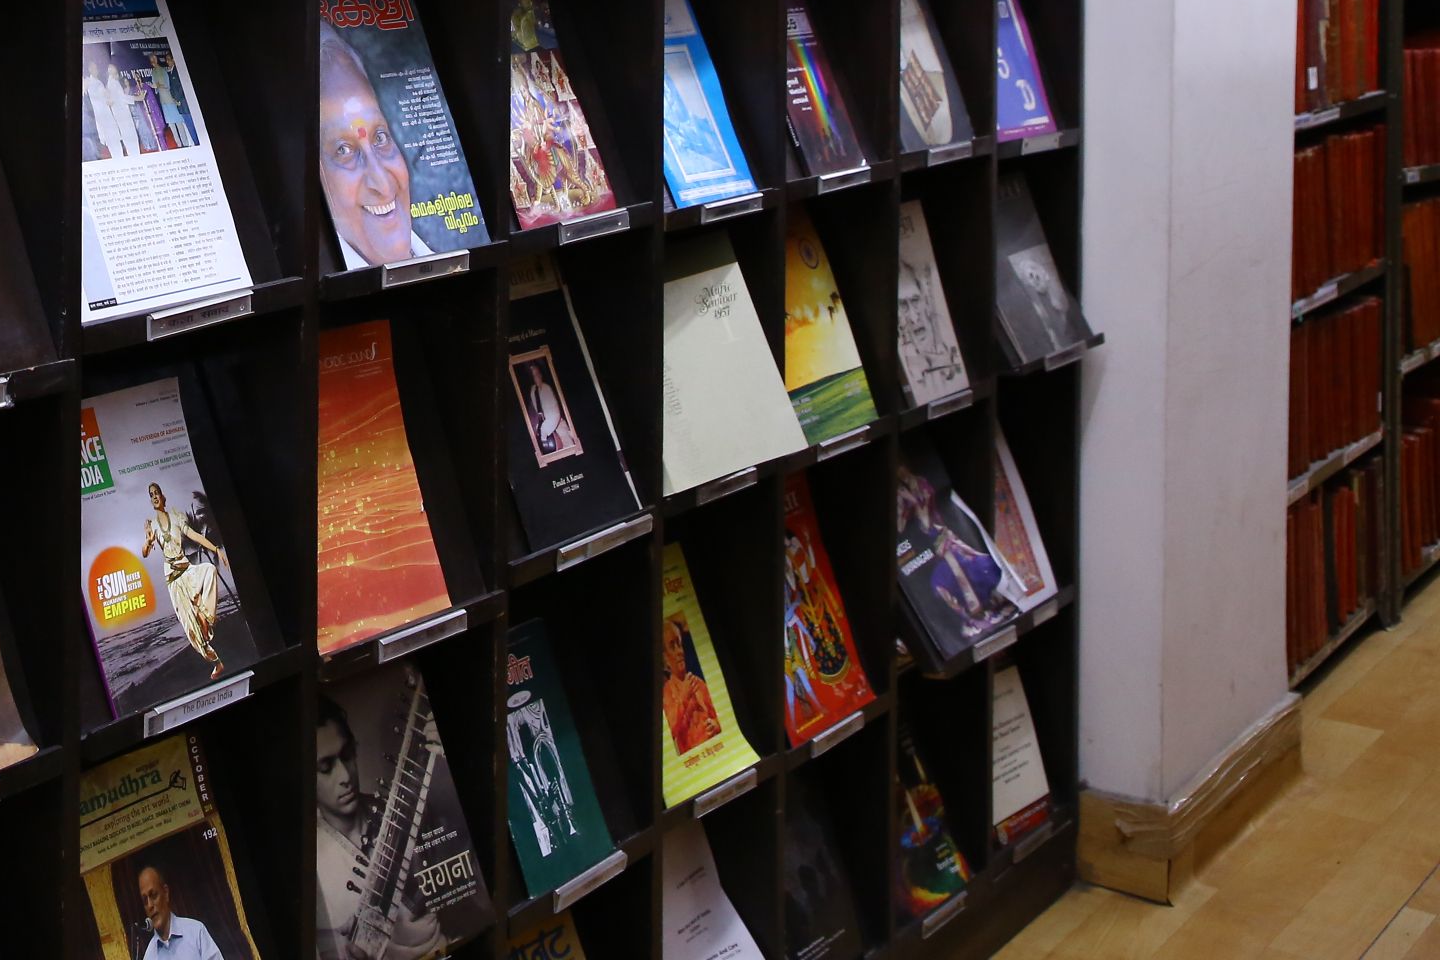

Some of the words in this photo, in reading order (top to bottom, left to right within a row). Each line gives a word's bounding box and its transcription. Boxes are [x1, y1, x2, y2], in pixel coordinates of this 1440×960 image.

[102, 569, 128, 599] SUN
[103, 594, 147, 620] EMPIRE
[182, 703, 196, 715] The
[196, 696, 216, 711] Dance
[216, 690, 233, 702] India
[202, 827, 218, 841] 192
[414, 849, 475, 897] संगना
